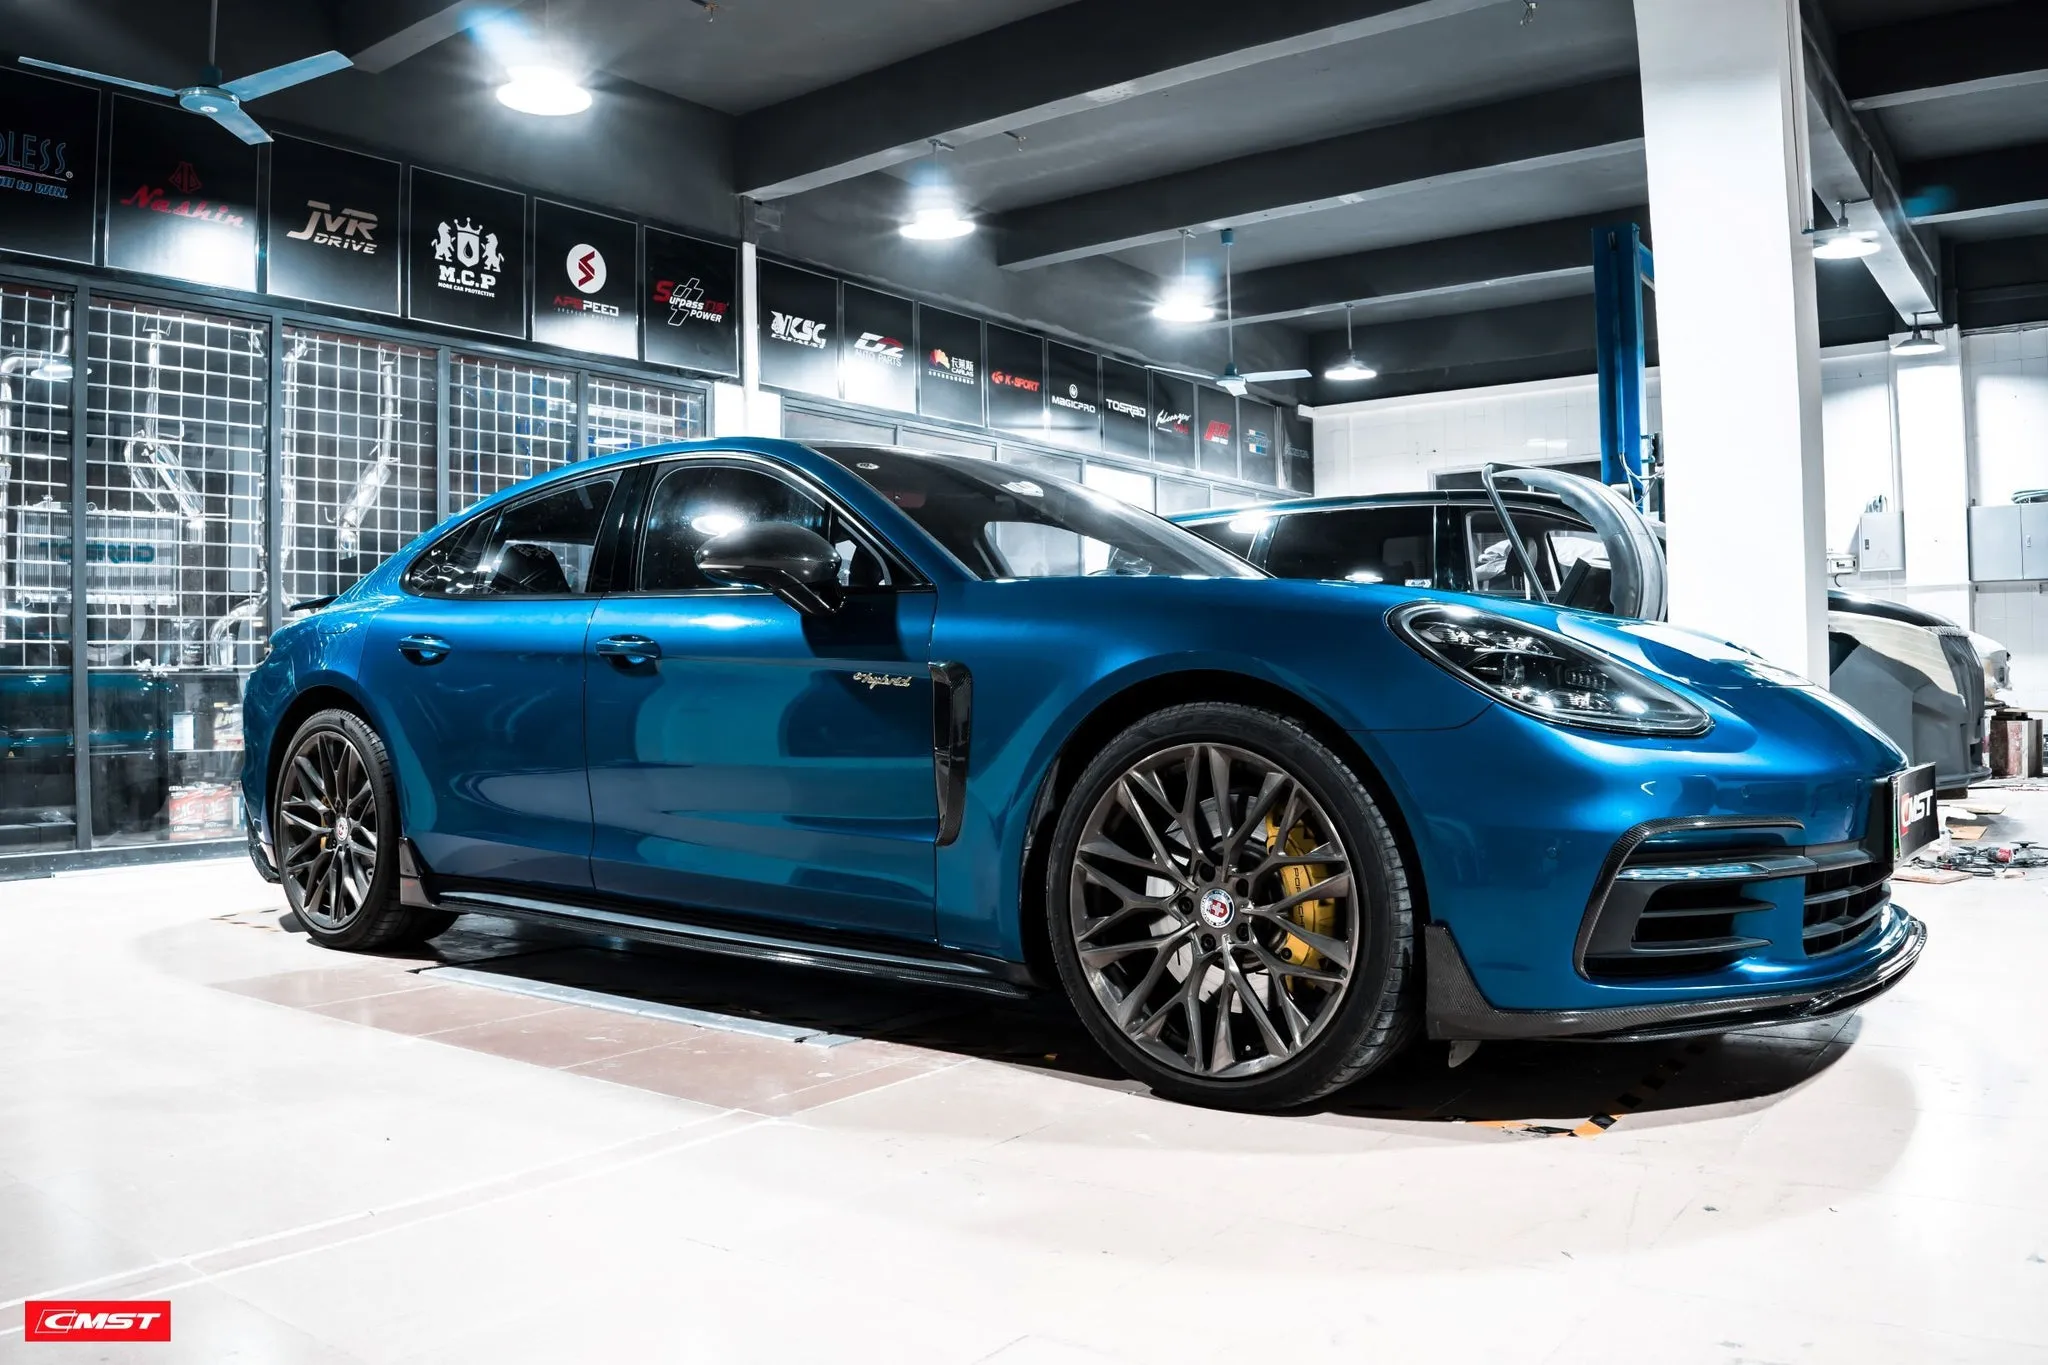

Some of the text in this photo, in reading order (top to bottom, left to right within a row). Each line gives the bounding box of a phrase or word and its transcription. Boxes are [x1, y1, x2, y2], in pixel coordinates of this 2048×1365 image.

[286, 200, 379, 241] JVR
[313, 232, 378, 255] DRIVE
[439, 264, 496, 290] M.C.P
[438, 282, 453, 290] MORE
[464, 287, 495, 298] PROTECTIVE
[689, 309, 722, 323] POWER
